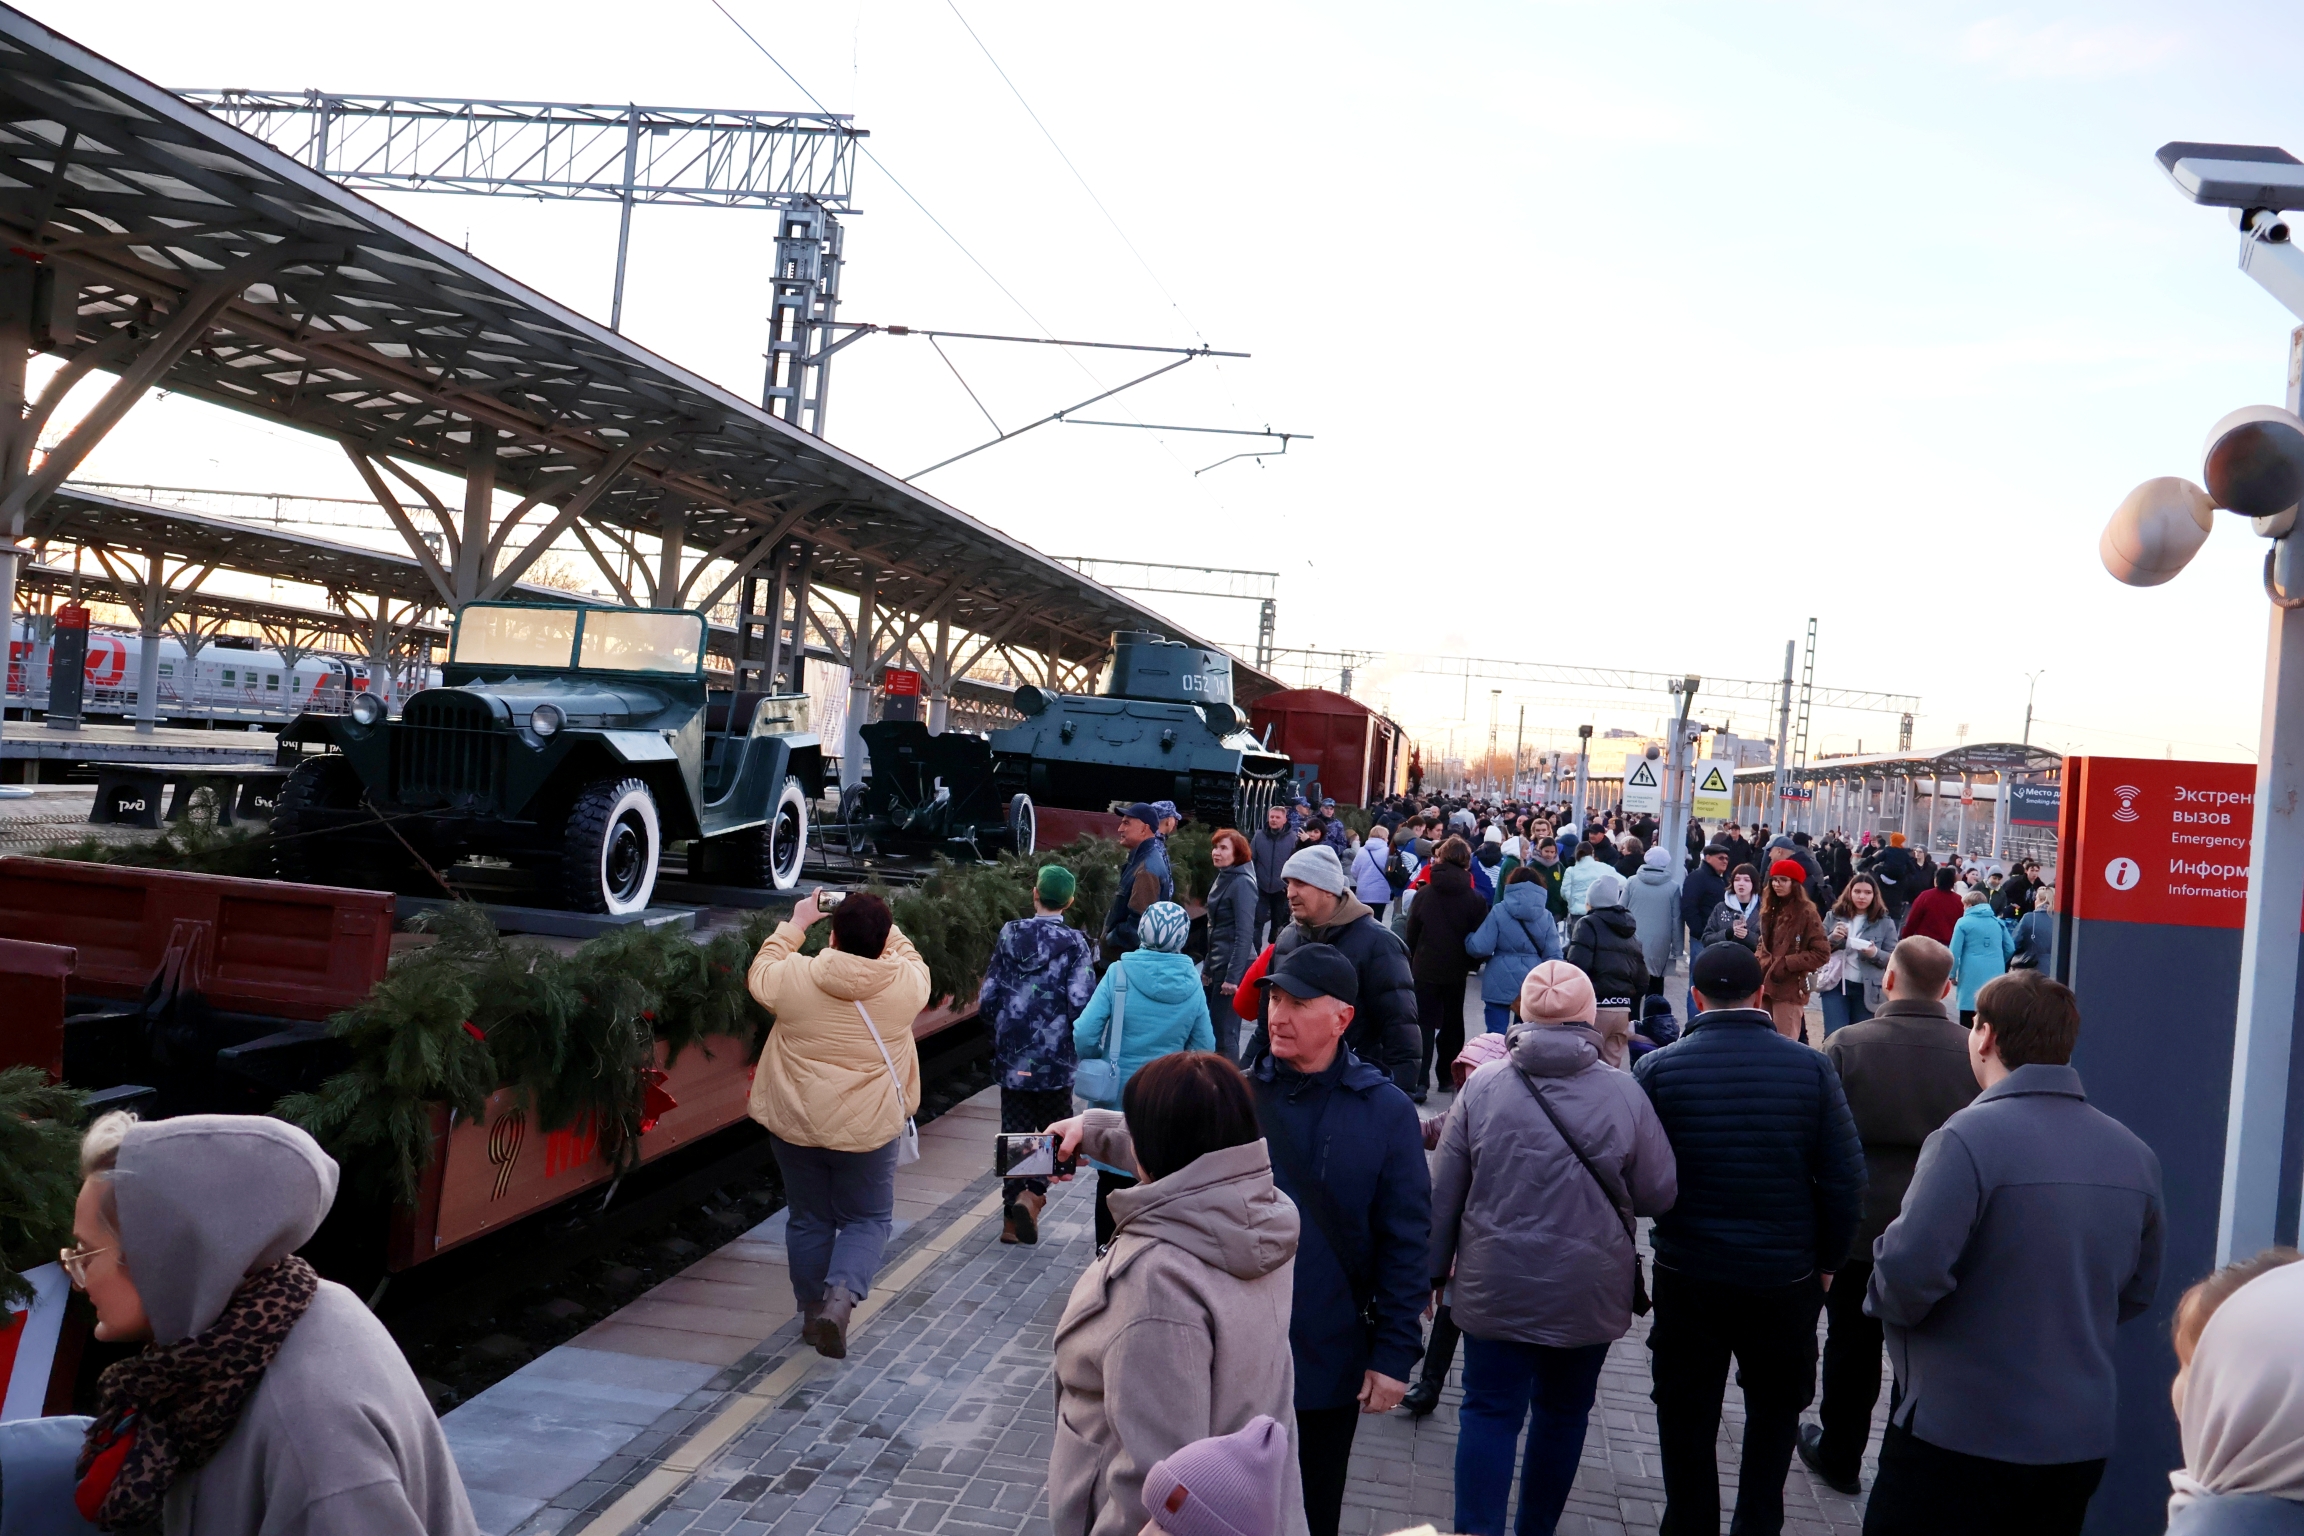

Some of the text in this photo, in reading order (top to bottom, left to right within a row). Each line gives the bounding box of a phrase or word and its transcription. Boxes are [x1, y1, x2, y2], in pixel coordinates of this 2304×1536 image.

[1183, 675, 1209, 692] 052
[1782, 787, 1794, 796] 16
[1799, 789, 1810, 798] 15
[2026, 788, 2052, 796] Место
[2173, 811, 2231, 824] вызов
[2171, 832, 2246, 849] Emergency
[2170, 858, 2250, 880] Информ
[2168, 883, 2248, 900] Information
